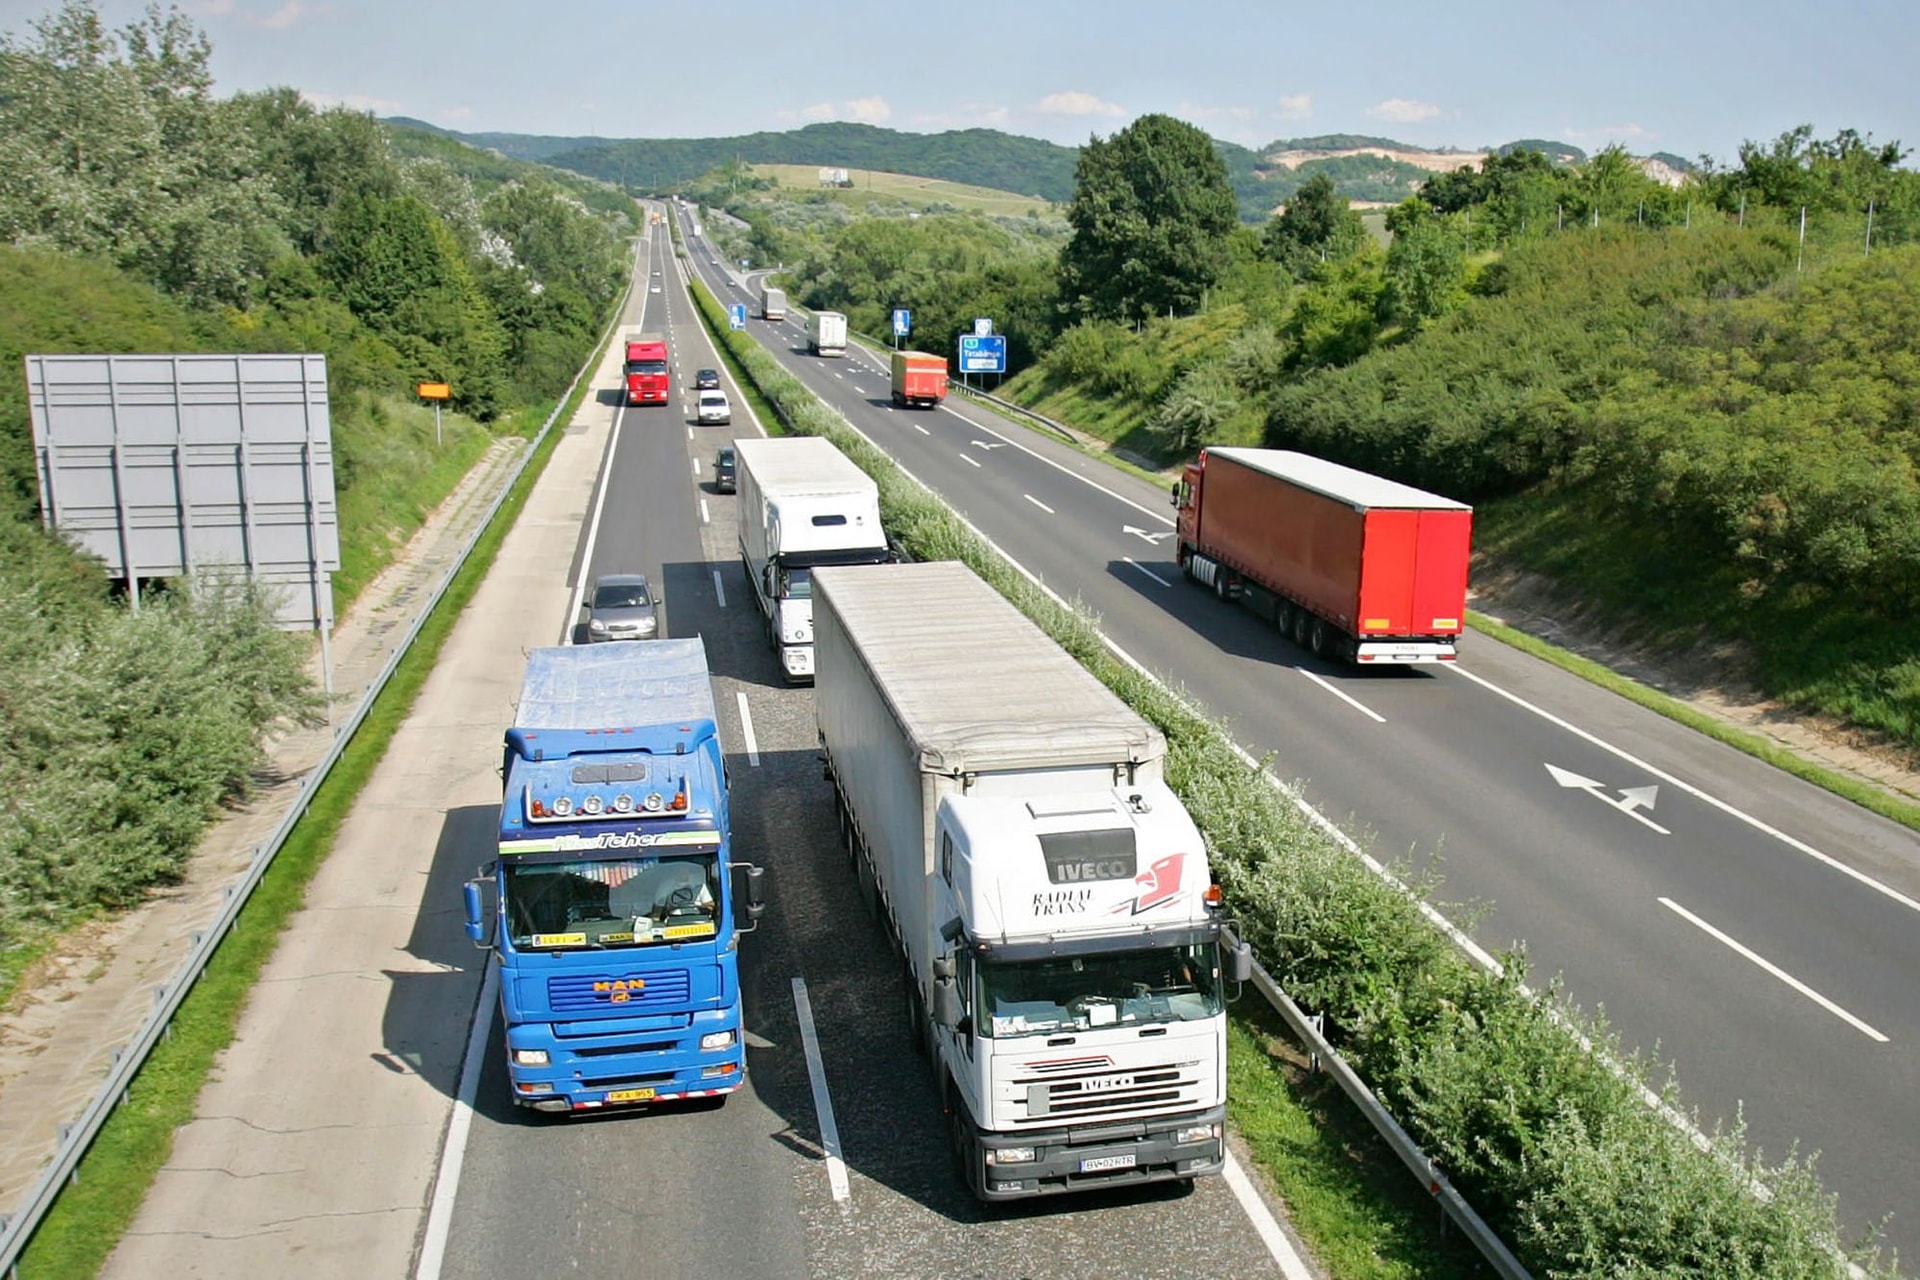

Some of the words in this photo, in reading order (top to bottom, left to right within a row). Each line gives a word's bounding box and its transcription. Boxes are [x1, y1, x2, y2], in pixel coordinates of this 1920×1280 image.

[1057, 861, 1128, 881] IVECO
[1032, 889, 1096, 905] RADIAL
[1033, 902, 1088, 917] TRANS
[592, 979, 645, 992] MAN
[1081, 1076, 1134, 1091] IVECO
